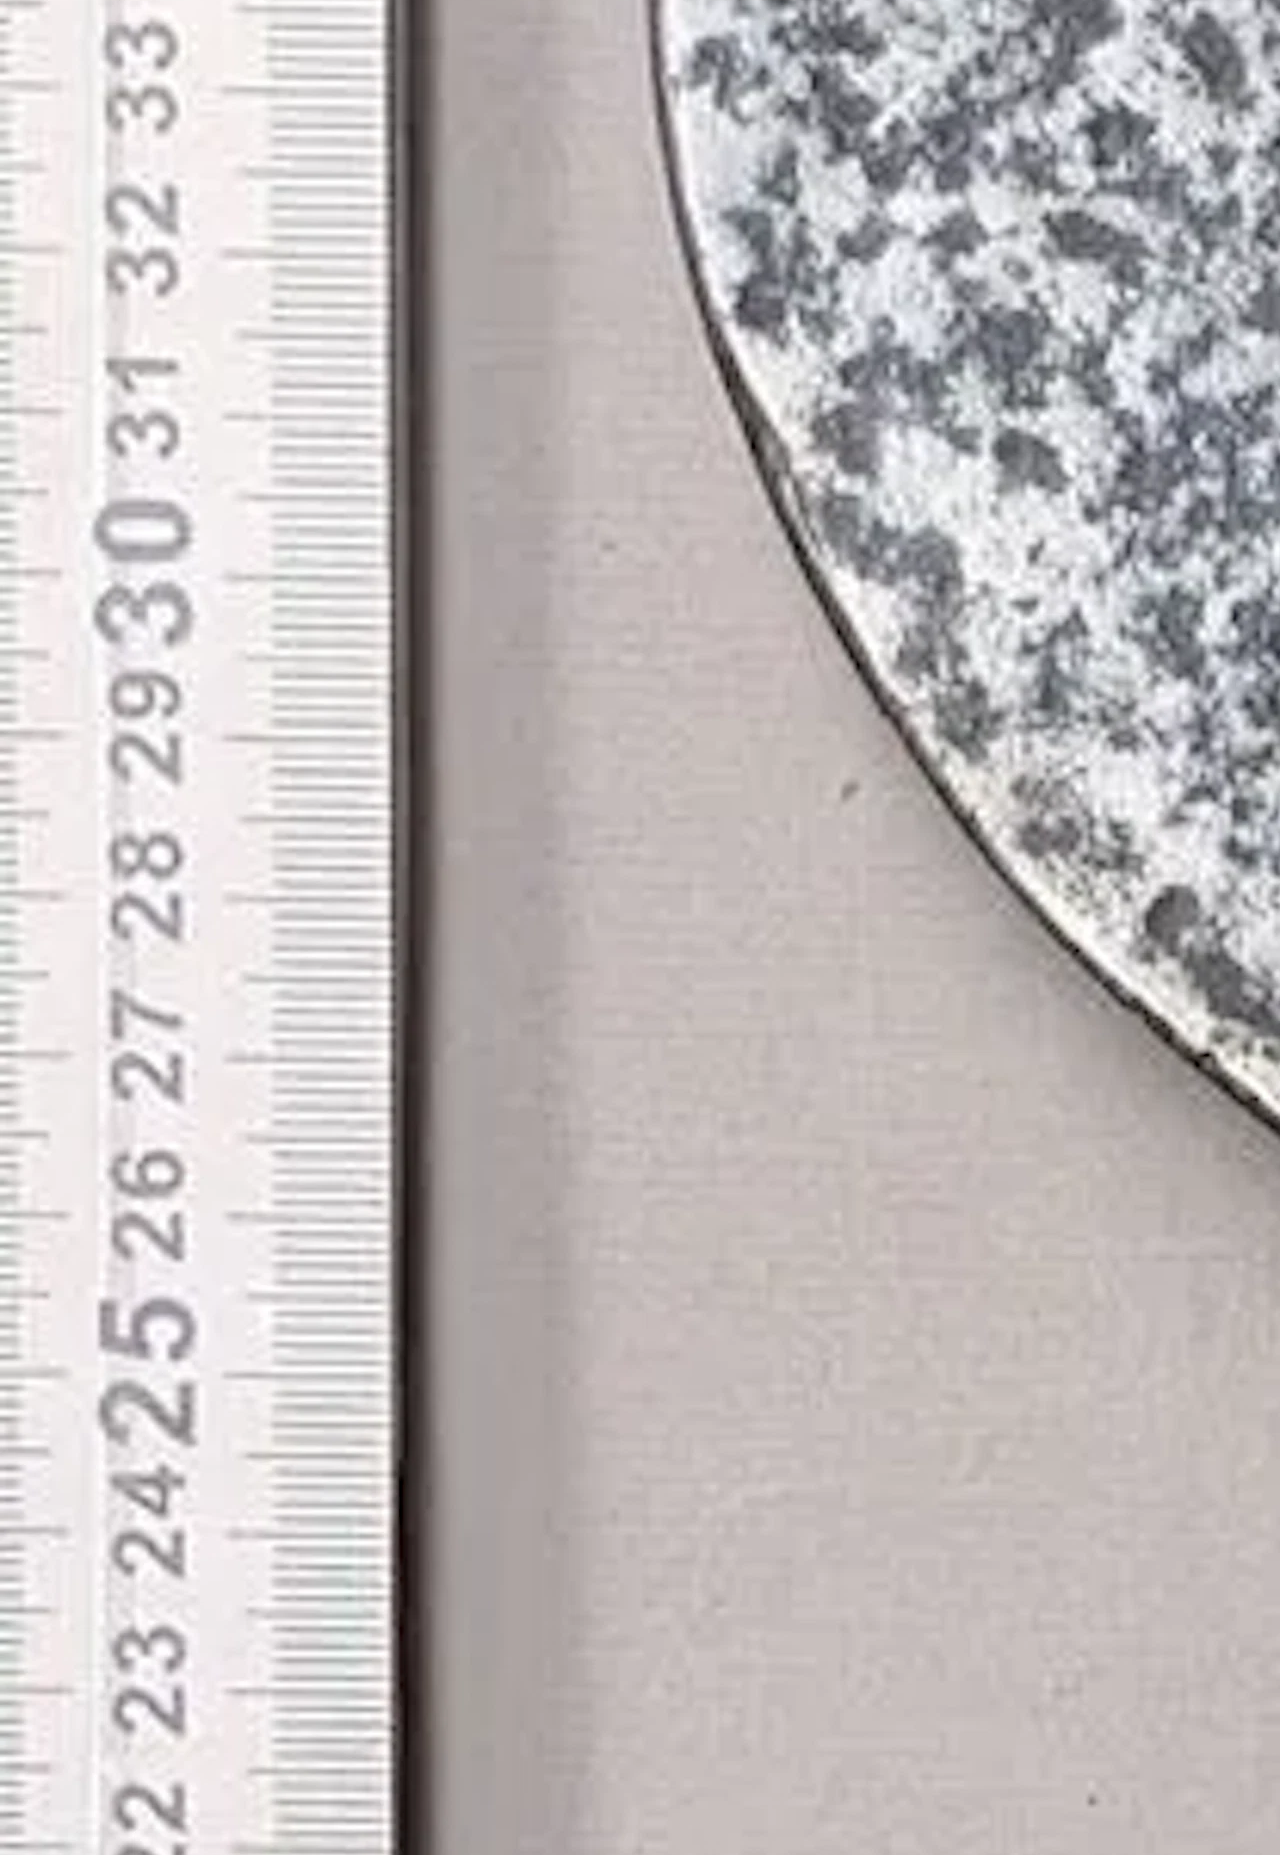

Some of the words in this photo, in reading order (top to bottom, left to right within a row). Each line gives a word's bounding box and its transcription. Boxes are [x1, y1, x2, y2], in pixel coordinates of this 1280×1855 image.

[103, 20, 179, 134] 33
[103, 184, 180, 298] 32
[104, 356, 180, 459] 31
[92, 499, 194, 648] 30
[107, 670, 183, 785] 29
[108, 832, 184, 941] 28
[109, 988, 184, 1103] 27
[108, 1149, 186, 1262] 26
[98, 1297, 197, 1446] 25
[109, 1464, 186, 1578] 24
[109, 1625, 187, 1736] 23
